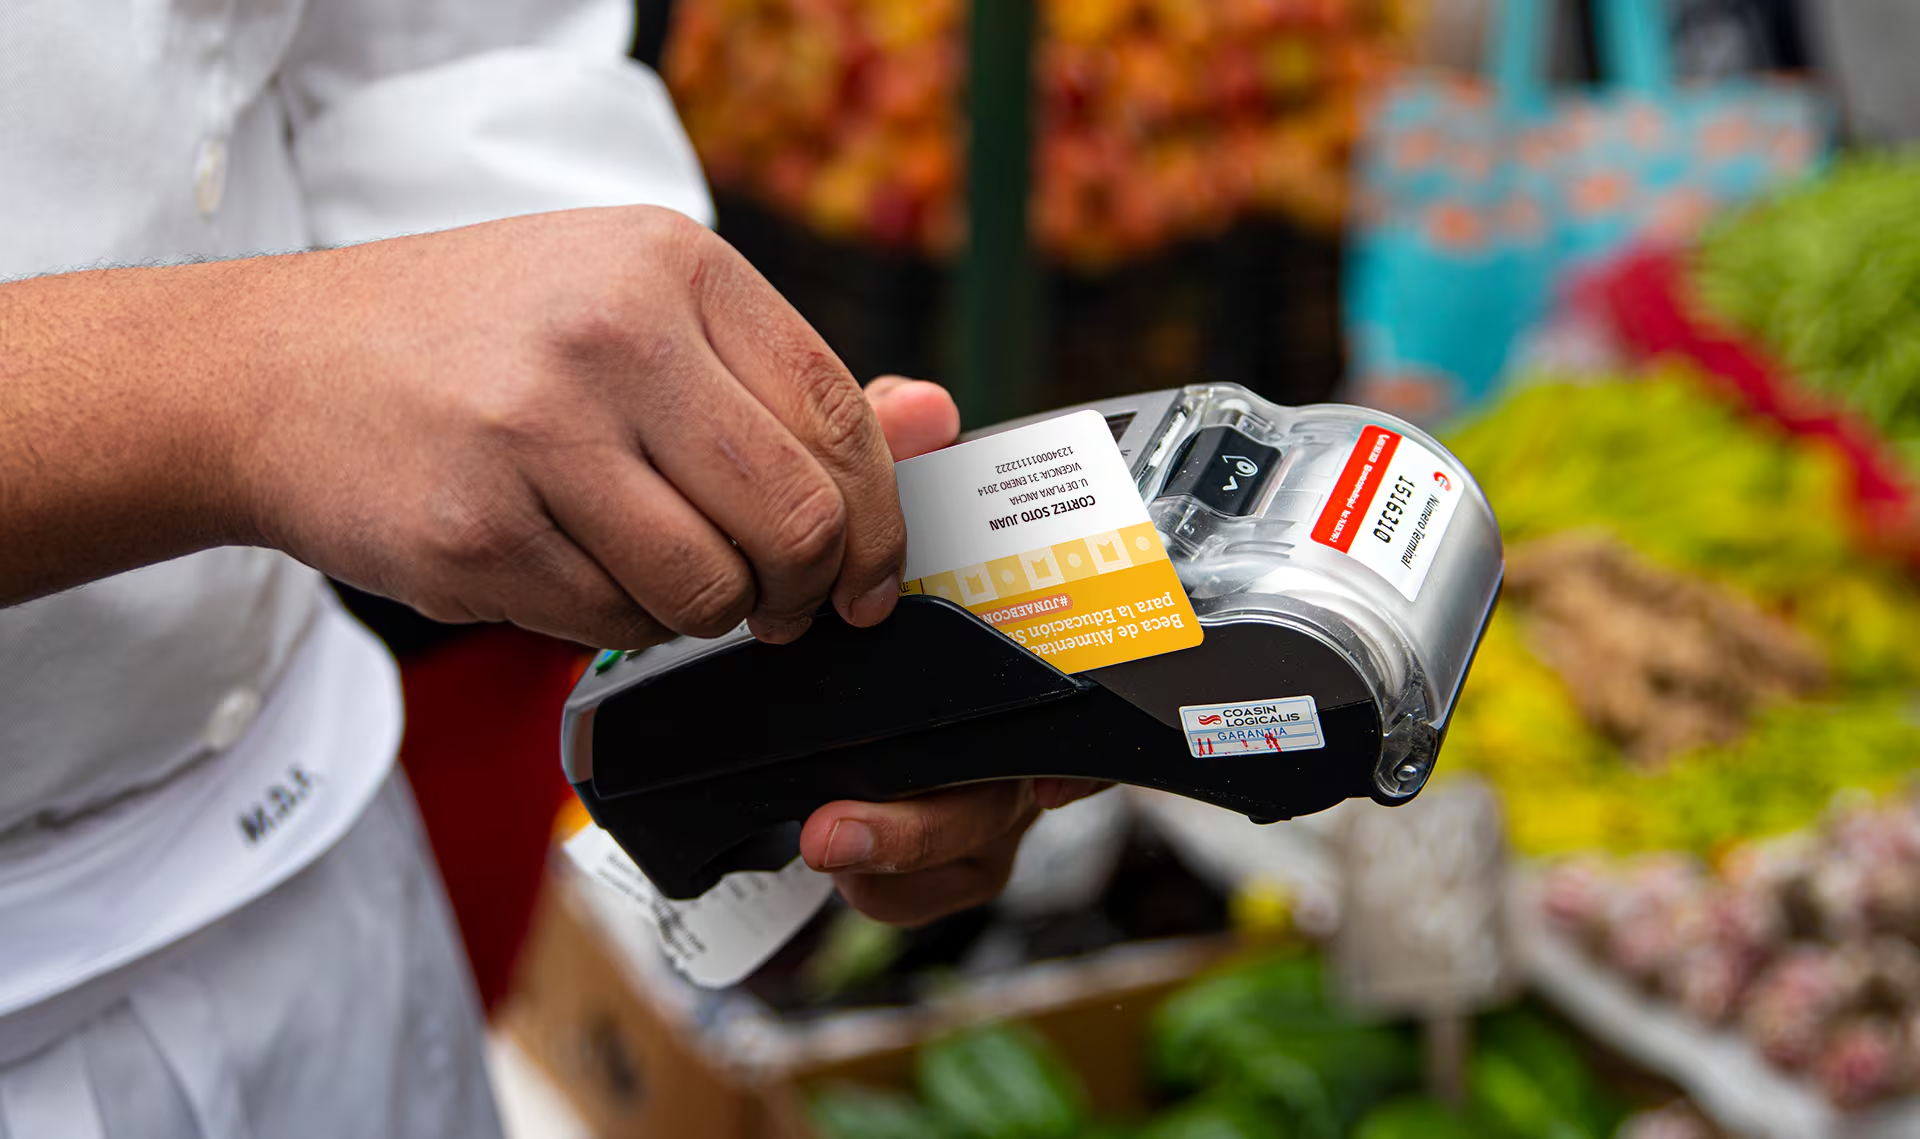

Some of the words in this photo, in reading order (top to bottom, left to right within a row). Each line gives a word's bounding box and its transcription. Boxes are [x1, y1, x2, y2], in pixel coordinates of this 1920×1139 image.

[995, 446, 1074, 474] 123400011112222
[1028, 473, 1039, 483] 31
[1039, 462, 1082, 479] VIGENCIA:
[977, 483, 999, 496] 2014
[999, 477, 1027, 490] ENERO
[1039, 484, 1066, 498] PLAYA
[1066, 480, 1078, 492] DE
[1078, 478, 1088, 487] U.
[1009, 491, 1038, 505] ANCHA
[1051, 495, 1095, 515] CORTEZ
[1021, 506, 1050, 523] SOTO
[1373, 475, 1415, 543] 1516310
[1419, 494, 1440, 530] Número
[989, 514, 1018, 531] JUAN
[1401, 529, 1425, 570] Terminal
[977, 595, 1068, 623] #JUNAEBCON
[1135, 592, 1175, 611] para
[1116, 605, 1134, 620] la
[1026, 607, 1115, 640] Educación
[1116, 622, 1138, 642] de
[1141, 612, 1184, 635] Beca
[1024, 628, 1115, 656] Alimentac
[1222, 705, 1277, 717] COASIN
[1226, 713, 1300, 727] LOGICALIS
[1217, 727, 1287, 741] GARANTIA
